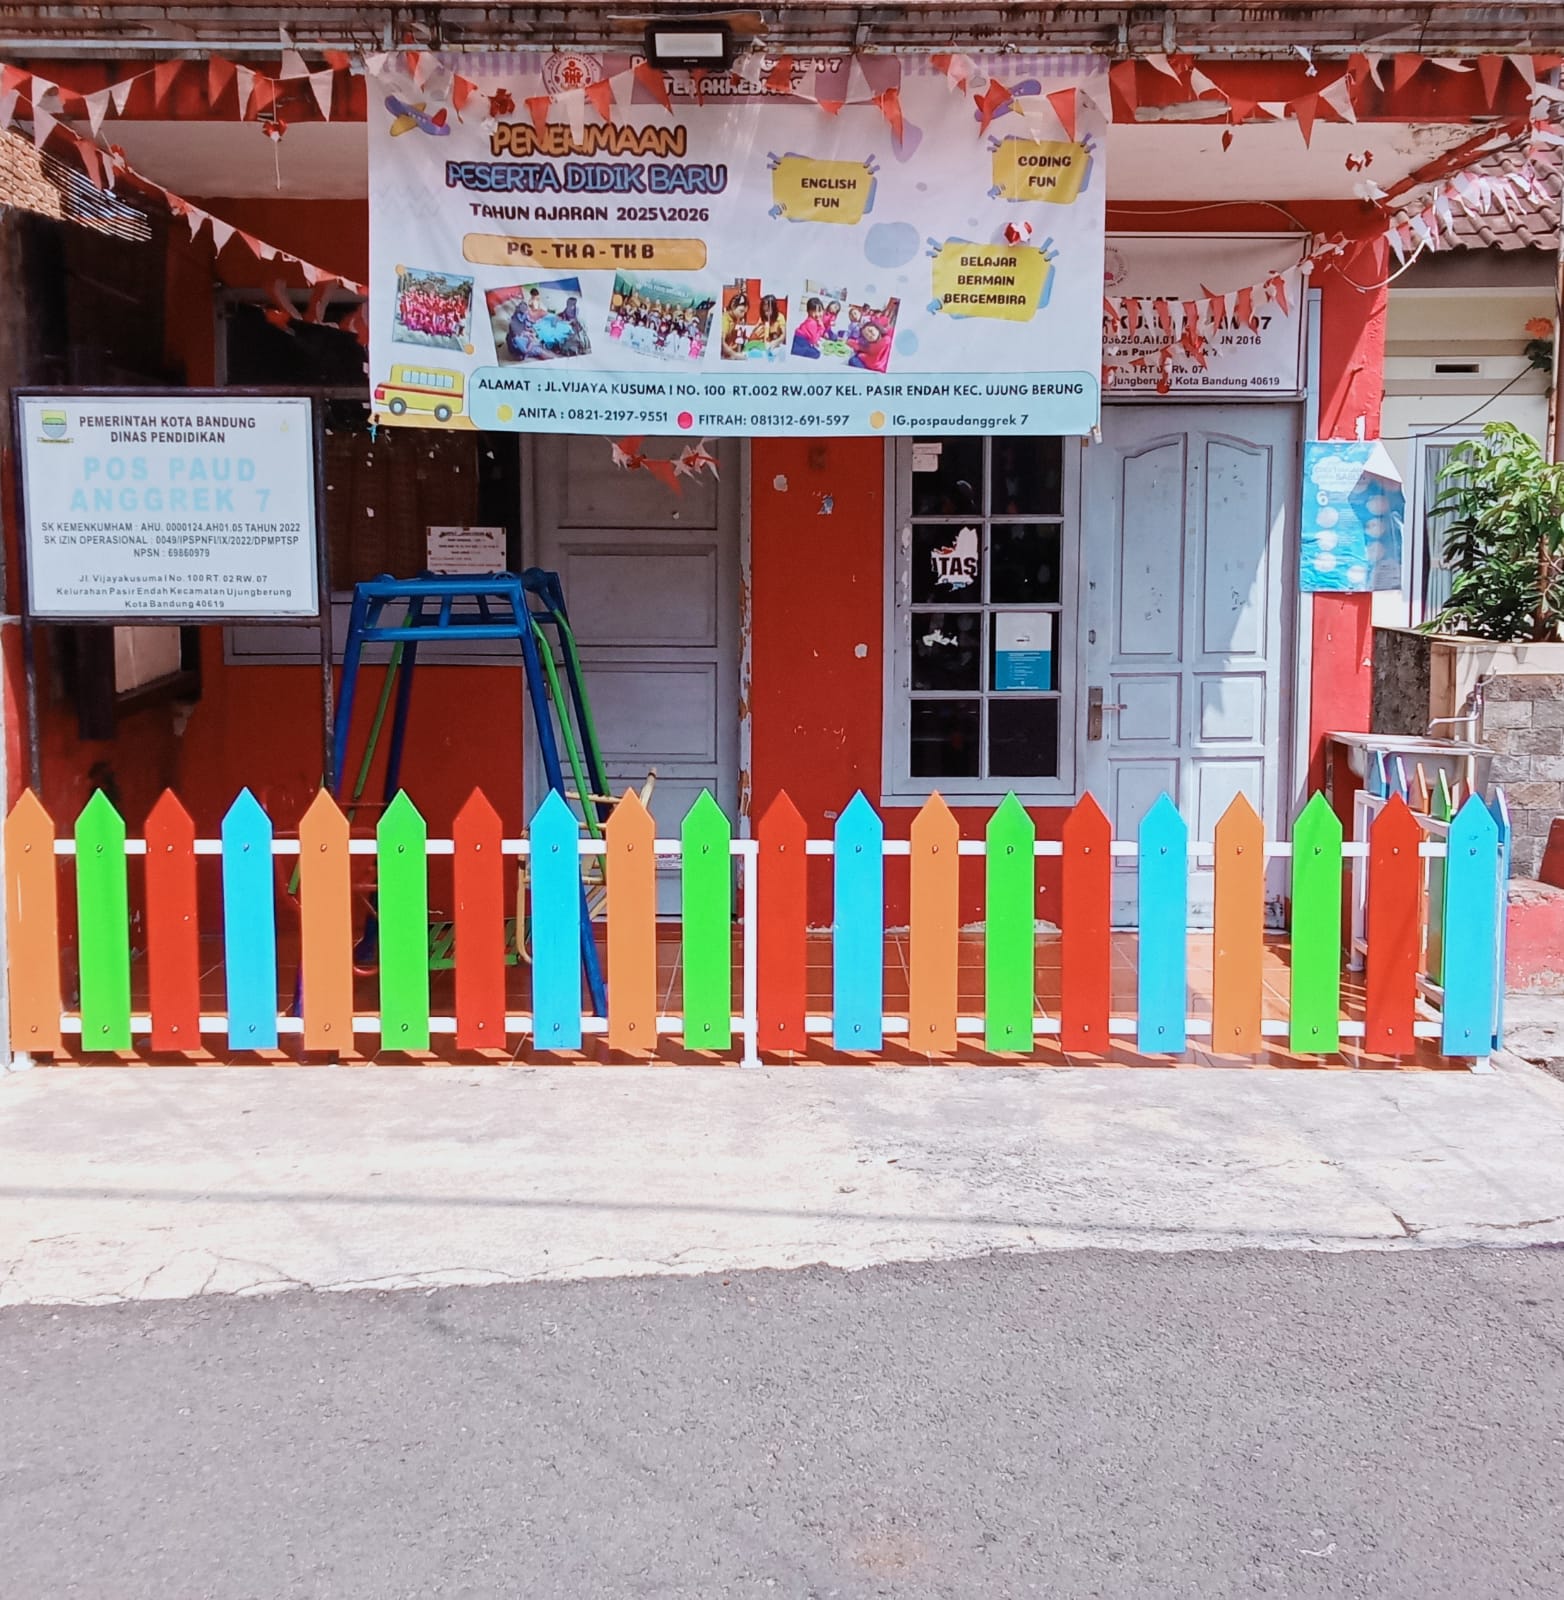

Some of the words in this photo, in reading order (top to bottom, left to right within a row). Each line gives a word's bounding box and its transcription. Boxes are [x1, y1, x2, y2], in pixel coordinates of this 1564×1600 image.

[490, 122, 687, 157] PENERIMAAN
[1018, 155, 1072, 168] CODING
[446, 161, 560, 191] PESERTA
[564, 162, 646, 193] DIDIK
[648, 163, 727, 194] BARU
[1028, 176, 1057, 187] FUN
[801, 178, 857, 190] ENGLISH
[814, 197, 840, 208] FUN
[470, 203, 530, 220] TAHUN
[535, 206, 608, 220] AJARAN
[617, 207, 710, 222] 2025\2026
[507, 242, 533, 256] PG
[552, 244, 578, 258] TK
[582, 244, 595, 258] A
[611, 244, 637, 258] TK
[642, 244, 654, 258] B
[960, 256, 1017, 267] BELAJAR
[957, 275, 1015, 286] BERMAIN
[944, 293, 1026, 305] BERGEMBIRA
[1236, 335, 1262, 345] 2016
[1175, 377, 1199, 385] Kota
[1202, 377, 1248, 387] Bandung
[1250, 376, 1280, 385] 40619
[479, 379, 530, 392] ALAMAT
[545, 381, 608, 394] JL.VIJAYA
[611, 383, 665, 395] KUSUMA
[677, 385, 700, 396] NO.
[704, 385, 726, 396] 100
[733, 385, 778, 397] RT.002
[781, 385, 832, 396] RW.007
[836, 385, 862, 396] KEL.
[867, 385, 903, 396] PASIR
[907, 385, 950, 396] ENDAH
[953, 384, 982, 396] KEC.
[985, 384, 1028, 396] UJUNG
[1032, 383, 1084, 395] BERUNG
[79, 416, 157, 428] PEMERINTAH
[161, 416, 193, 428] KOTA
[196, 416, 256, 429] BANDUNG
[518, 407, 557, 420] ANITA
[568, 409, 668, 423] 0821-2197-9551
[699, 414, 747, 426] FITRAH:
[750, 414, 850, 426] 081312-691-597
[892, 414, 1016, 428] IG.pospaudanggrek
[1020, 414, 1029, 426] 7
[111, 431, 147, 443] DINAS
[151, 431, 226, 443] PENDIDIKAN
[84, 457, 148, 481] POS
[169, 457, 257, 481] PAUD
[70, 488, 235, 512] ANGGREK
[256, 488, 272, 512] 7
[42, 522, 55, 532] SK
[57, 522, 133, 532] KEMENKUMHAM
[245, 523, 277, 532] TAHUN
[280, 523, 300, 532] 2022
[44, 535, 57, 544] SK
[59, 536, 77, 544] IZIN
[80, 535, 148, 545] OPERASIONAL
[133, 548, 160, 557] NPSN
[93, 574, 161, 584] Vijayakusuma
[187, 574, 204, 582] 100
[223, 575, 234, 583] 02
[256, 575, 268, 583] 07
[56, 587, 107, 596] Kelurahan
[109, 587, 135, 596] Pasir
[137, 587, 168, 596] Endah
[170, 586, 225, 596] Kecamatan
[227, 587, 292, 597] Ujungberung
[125, 600, 147, 608] Kota
[150, 600, 194, 609] Bandung
